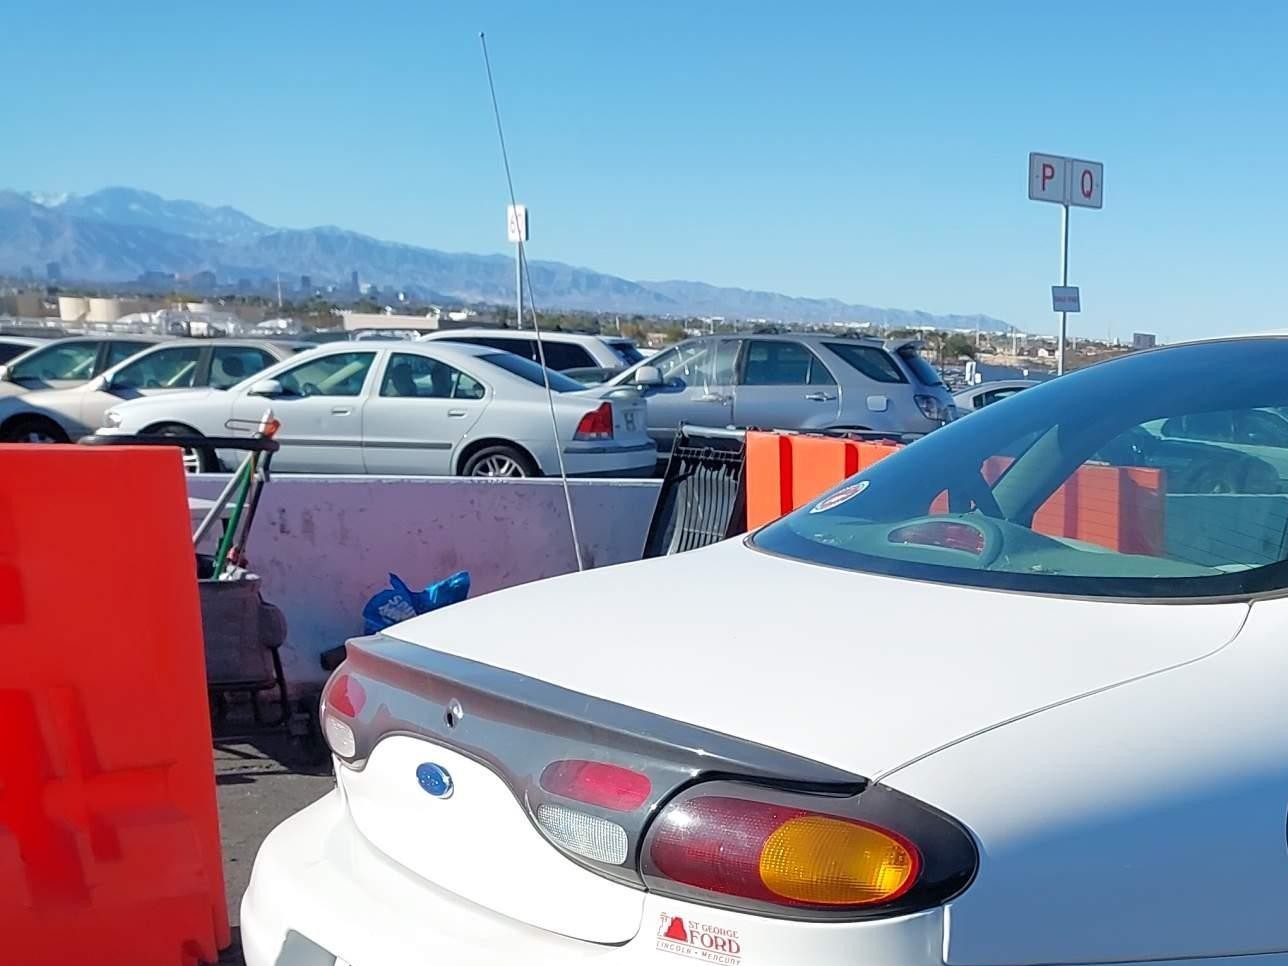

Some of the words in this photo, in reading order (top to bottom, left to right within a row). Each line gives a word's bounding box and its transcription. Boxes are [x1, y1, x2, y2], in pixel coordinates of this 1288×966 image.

[1042, 163, 1055, 192] P
[1081, 169, 1094, 200] Q
[688, 920, 700, 930] ST
[701, 924, 740, 939] GEORGE
[689, 929, 741, 954] FORD
[656, 941, 691, 954] LINCOLN
[701, 951, 741, 966] MERCURY
